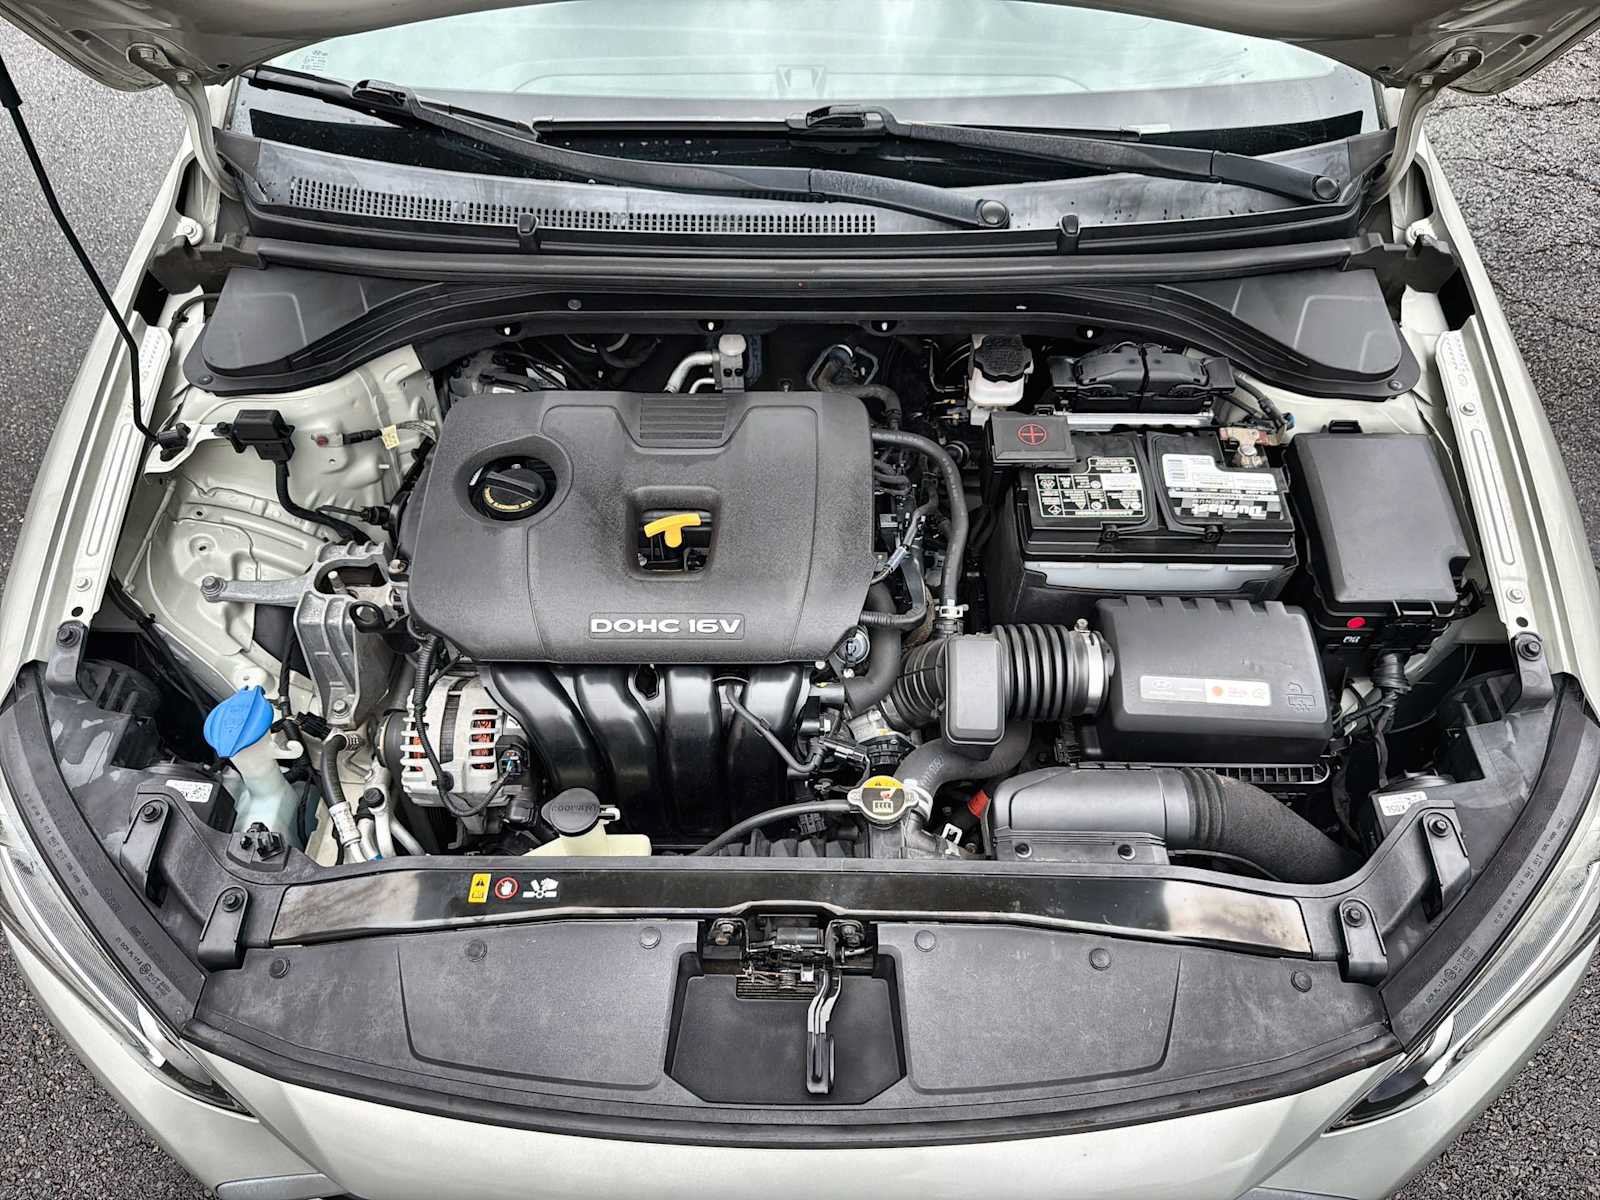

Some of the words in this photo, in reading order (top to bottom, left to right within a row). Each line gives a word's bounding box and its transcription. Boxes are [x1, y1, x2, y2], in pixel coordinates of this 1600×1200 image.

[1191, 504, 1267, 516] Duralast
[591, 618, 681, 633] DOHC
[688, 618, 741, 633] 16V
